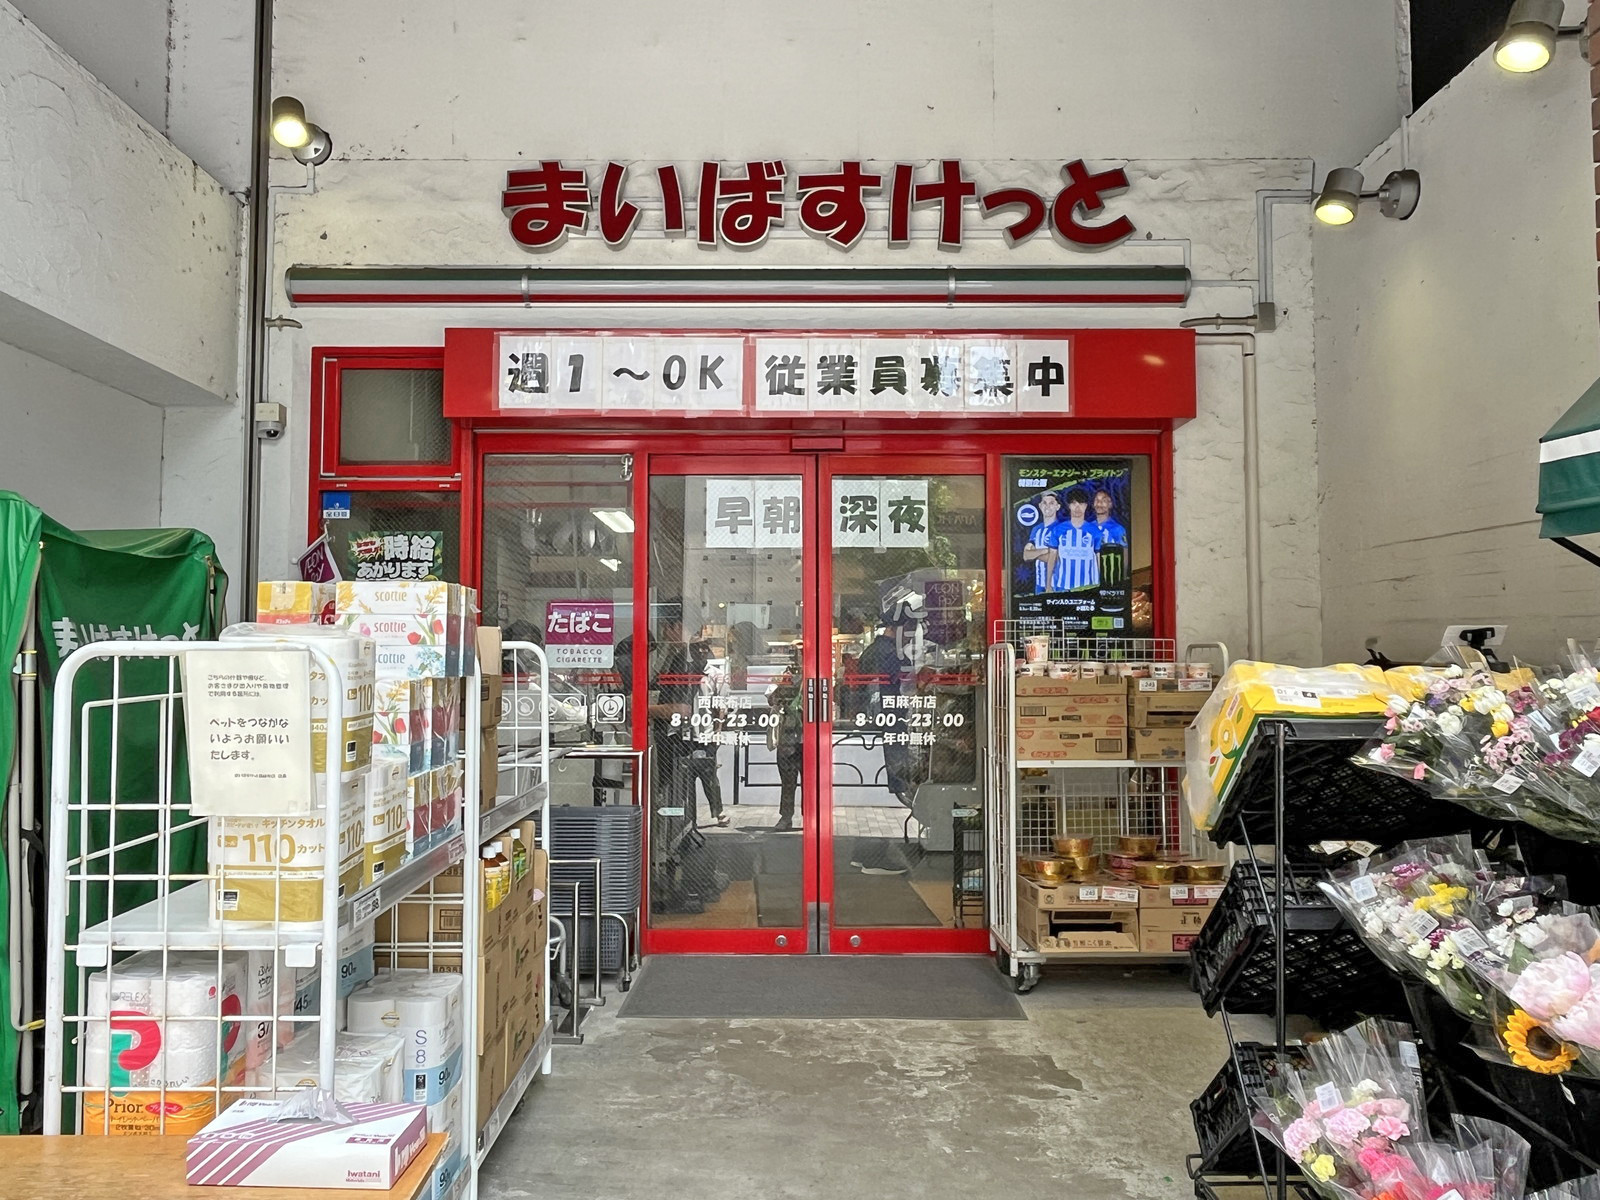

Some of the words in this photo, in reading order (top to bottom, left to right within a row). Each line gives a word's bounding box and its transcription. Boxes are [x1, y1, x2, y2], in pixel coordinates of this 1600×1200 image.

[502, 159, 1137, 252] まいばすけっと
[715, 496, 800, 533] 早朝
[840, 496, 926, 533] 深夜
[383, 534, 436, 561] 時給
[356, 561, 433, 578] あがります
[375, 590, 407, 602] scottie
[374, 621, 406, 633] scottie
[547, 610, 612, 634] たばこ
[376, 652, 405, 664] cottie
[698, 696, 752, 709] 西麻布店
[882, 696, 937, 709] 西麻布店
[210, 733, 290, 745] いようお願いい
[698, 732, 752, 745] 年中無休
[883, 732, 936, 745] 年中無休
[210, 750, 255, 761] たします。
[347, 1170, 381, 1178] Iwatani
